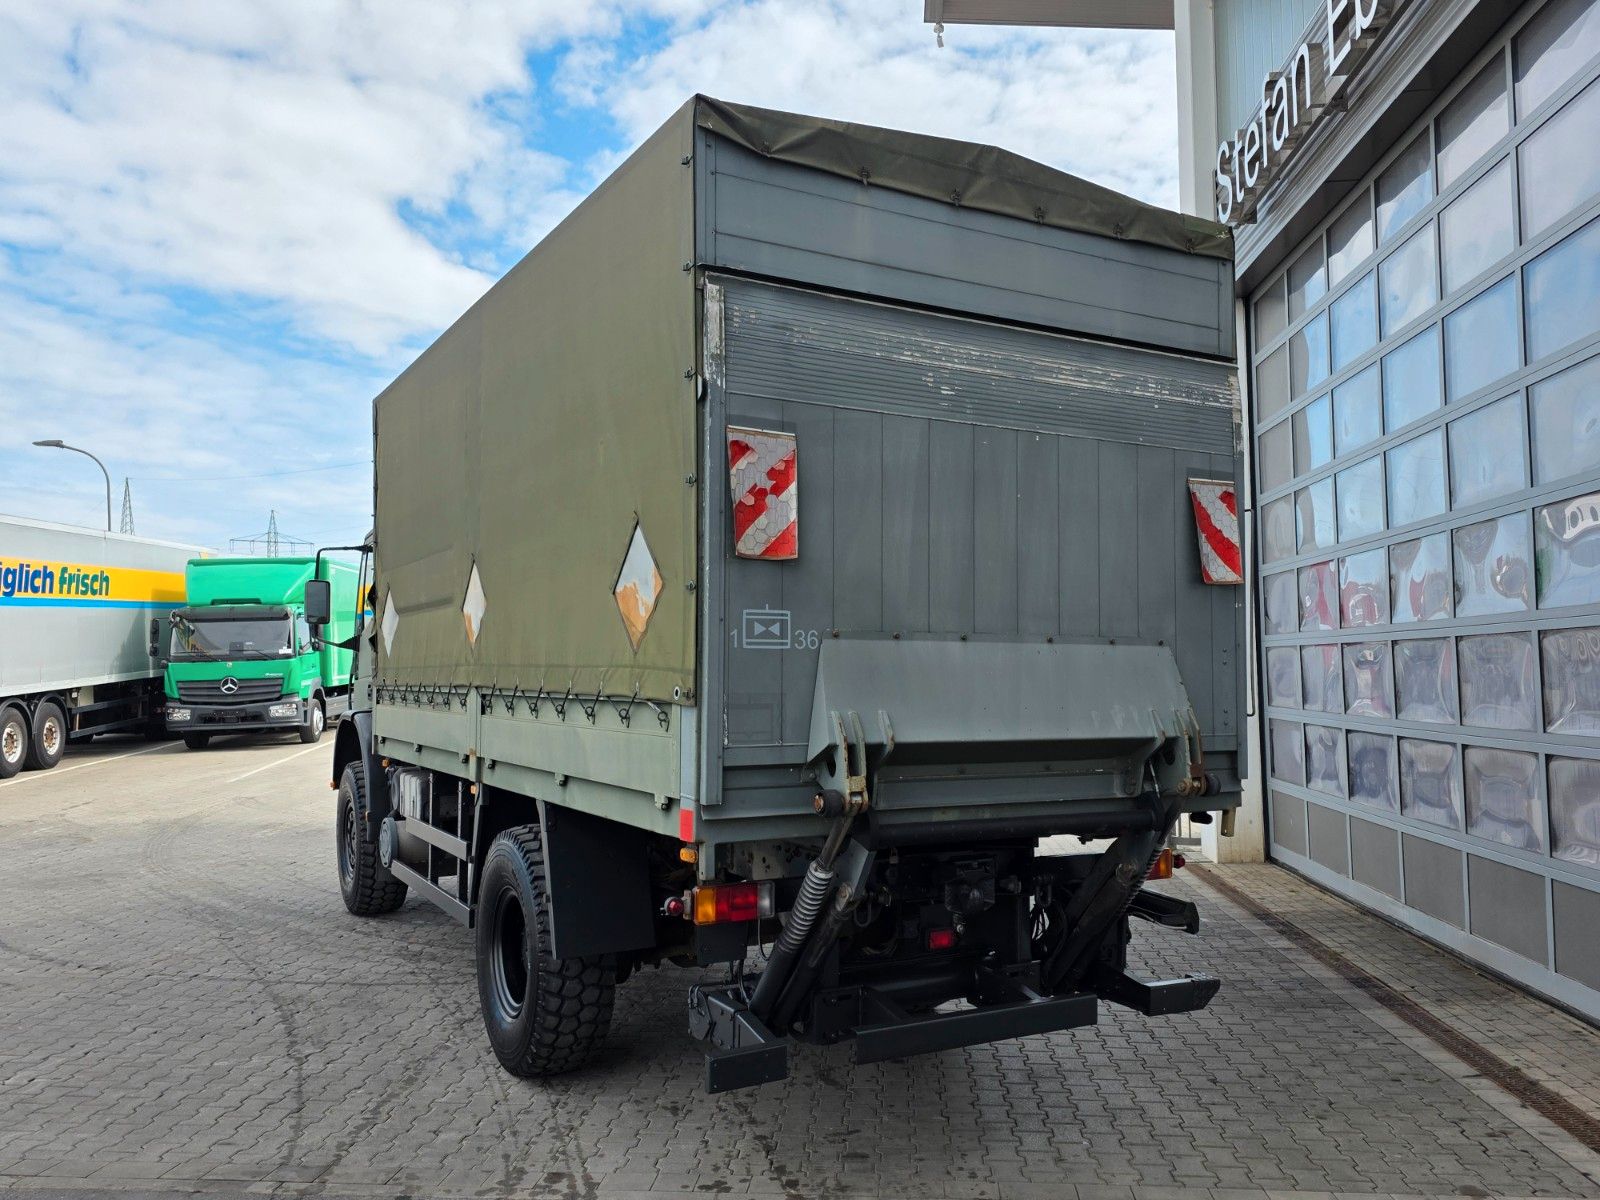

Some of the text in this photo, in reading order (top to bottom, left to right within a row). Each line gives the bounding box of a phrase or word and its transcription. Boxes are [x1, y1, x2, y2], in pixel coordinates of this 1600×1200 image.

[1217, 43, 1310, 223] Stefan
[0, 562, 110, 597] glich frisch
[730, 629, 819, 649] 1 36
